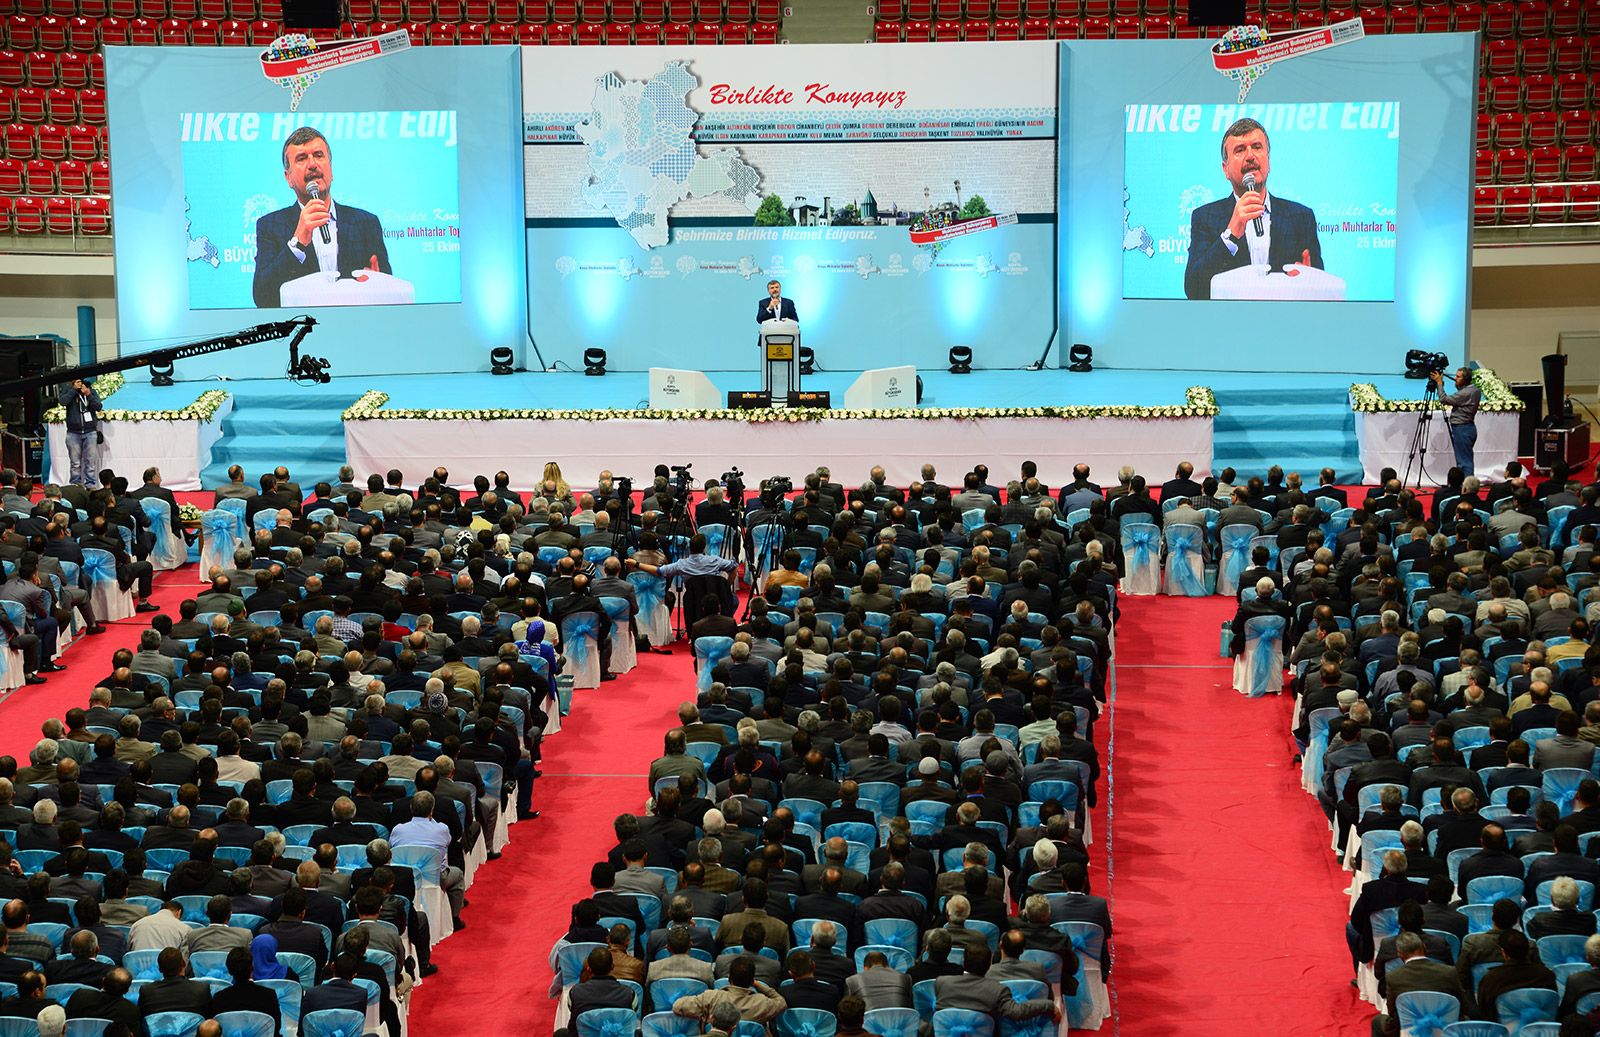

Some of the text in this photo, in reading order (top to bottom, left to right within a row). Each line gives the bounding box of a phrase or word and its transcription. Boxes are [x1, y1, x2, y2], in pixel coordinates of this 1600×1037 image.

[709, 82, 908, 110] Birlikte Konyayız
[407, 226, 446, 238] Muhtarlar
[1342, 221, 1383, 232] Muhtarlar
[675, 228, 878, 243] Şehrimize Birlikte Hizmet Ediyoruz.
[422, 240, 460, 252] 25 Ekim
[1357, 236, 1370, 249] 25
